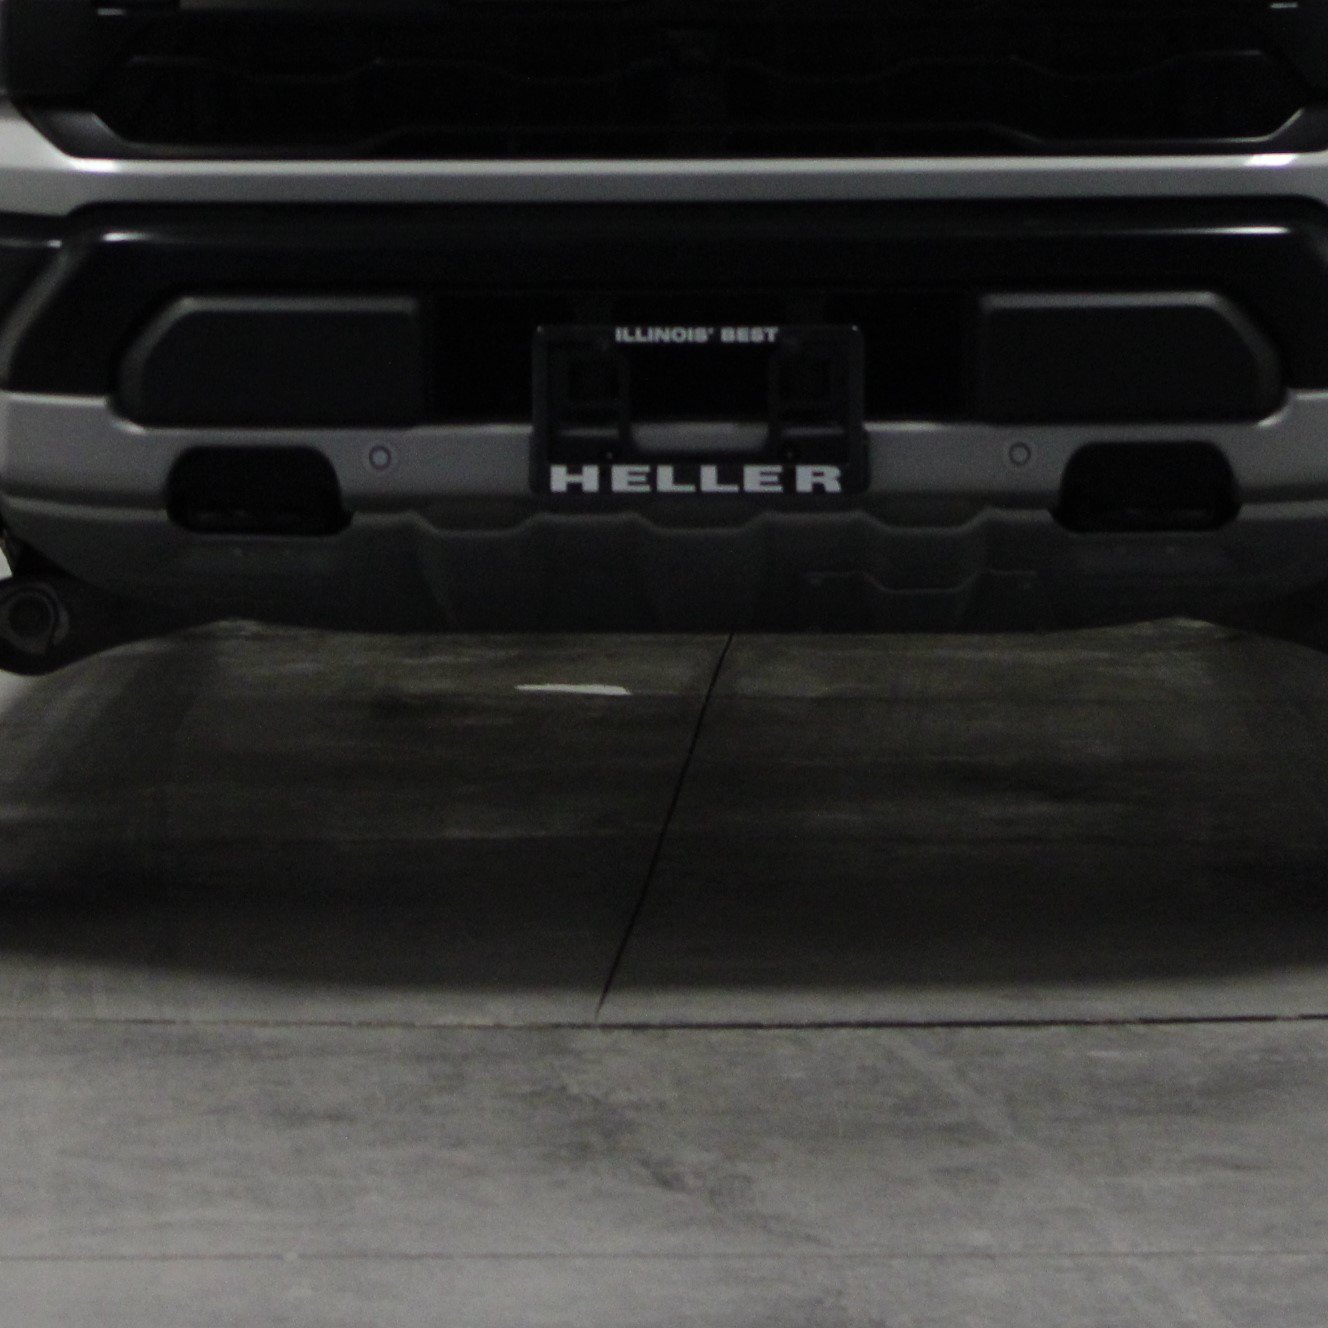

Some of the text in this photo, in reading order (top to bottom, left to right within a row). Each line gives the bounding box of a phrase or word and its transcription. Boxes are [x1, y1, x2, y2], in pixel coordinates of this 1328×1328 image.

[615, 326, 779, 343] ILLINOIS' BEST
[550, 464, 842, 493] HELLER
